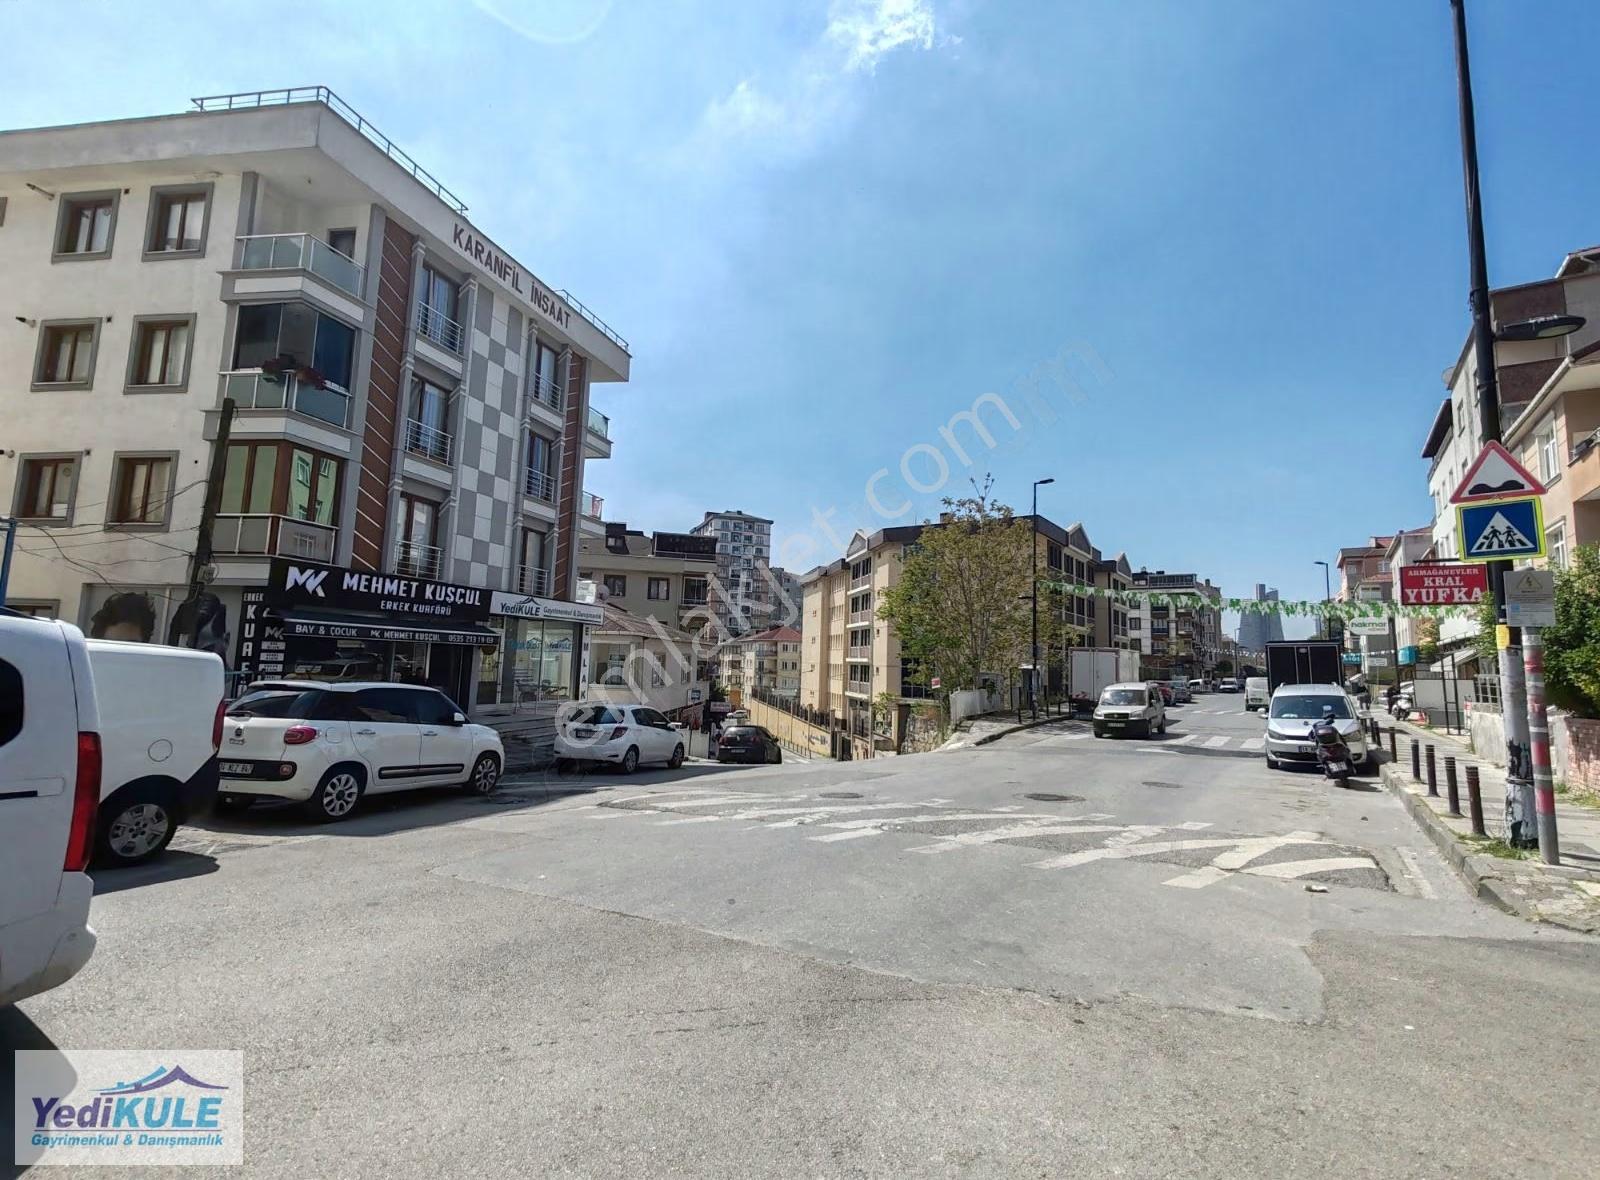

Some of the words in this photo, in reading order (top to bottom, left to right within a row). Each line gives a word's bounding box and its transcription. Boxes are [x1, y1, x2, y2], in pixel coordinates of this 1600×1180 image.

[453, 223, 523, 294] KARANFİL
[531, 281, 571, 329] İNŞAAT
[342, 572, 419, 599] MEHMET
[425, 583, 481, 606] KUŞÇUL
[1424, 576, 1464, 587] KRAL
[1405, 587, 1483, 603] YUFKA
[380, 600, 410, 612] ERKEK
[413, 603, 452, 616] KUAFÖRÜ
[500, 602, 541, 617] YediKULE
[295, 624, 315, 635] BAY
[318, 626, 326, 635] &
[330, 626, 358, 638] ÇOCUK
[384, 630, 413, 640] MEHMET
[237, 604, 257, 698] KUAFÖ
[581, 626, 591, 699] EMLAK
